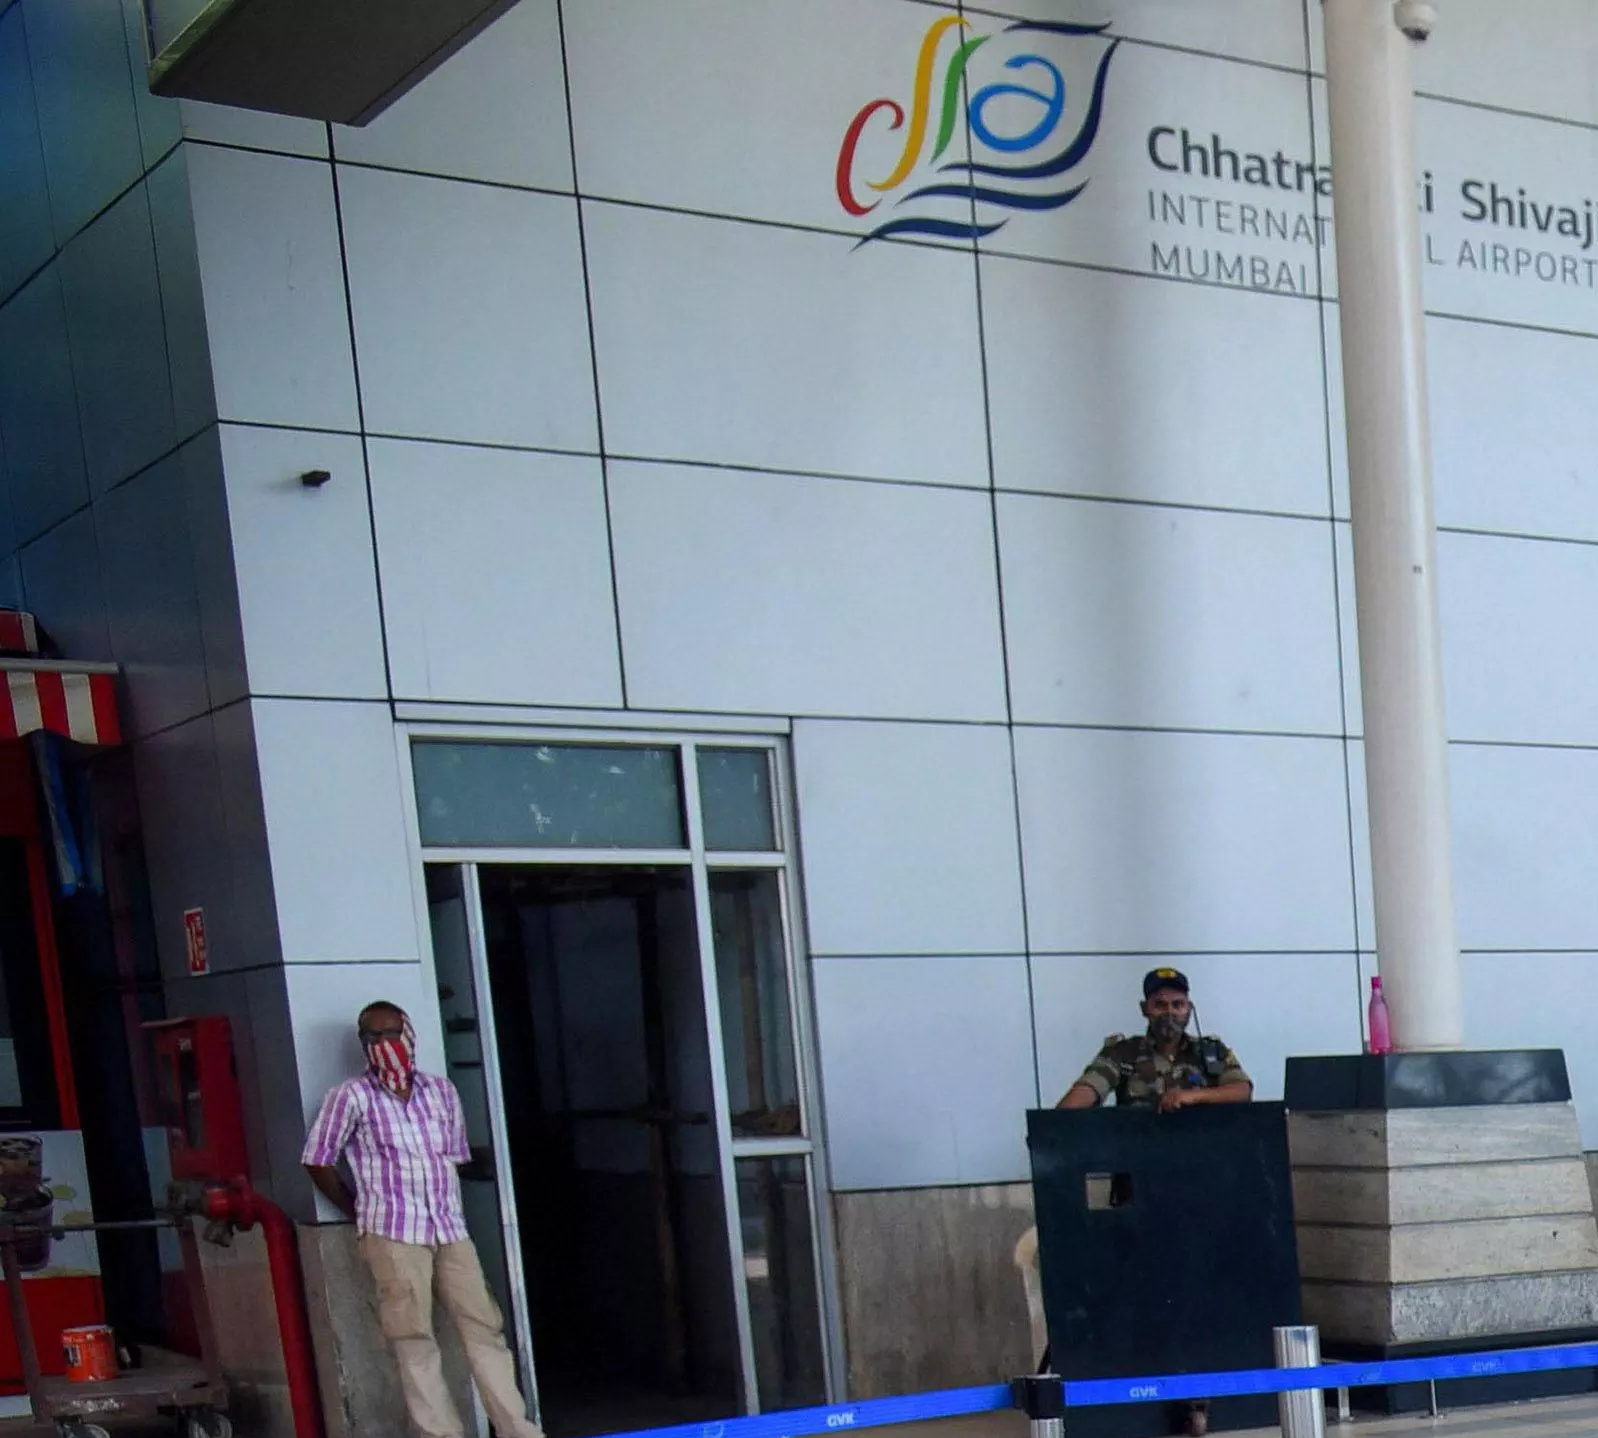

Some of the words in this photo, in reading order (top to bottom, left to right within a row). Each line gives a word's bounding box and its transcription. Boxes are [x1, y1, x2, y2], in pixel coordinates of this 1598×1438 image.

[1147, 125, 1435, 214] Chhatrai
[1148, 189, 1445, 266] INTERNATL
[1151, 240, 1309, 293] MUMBAI
[827, 1412, 856, 1428] GVK
